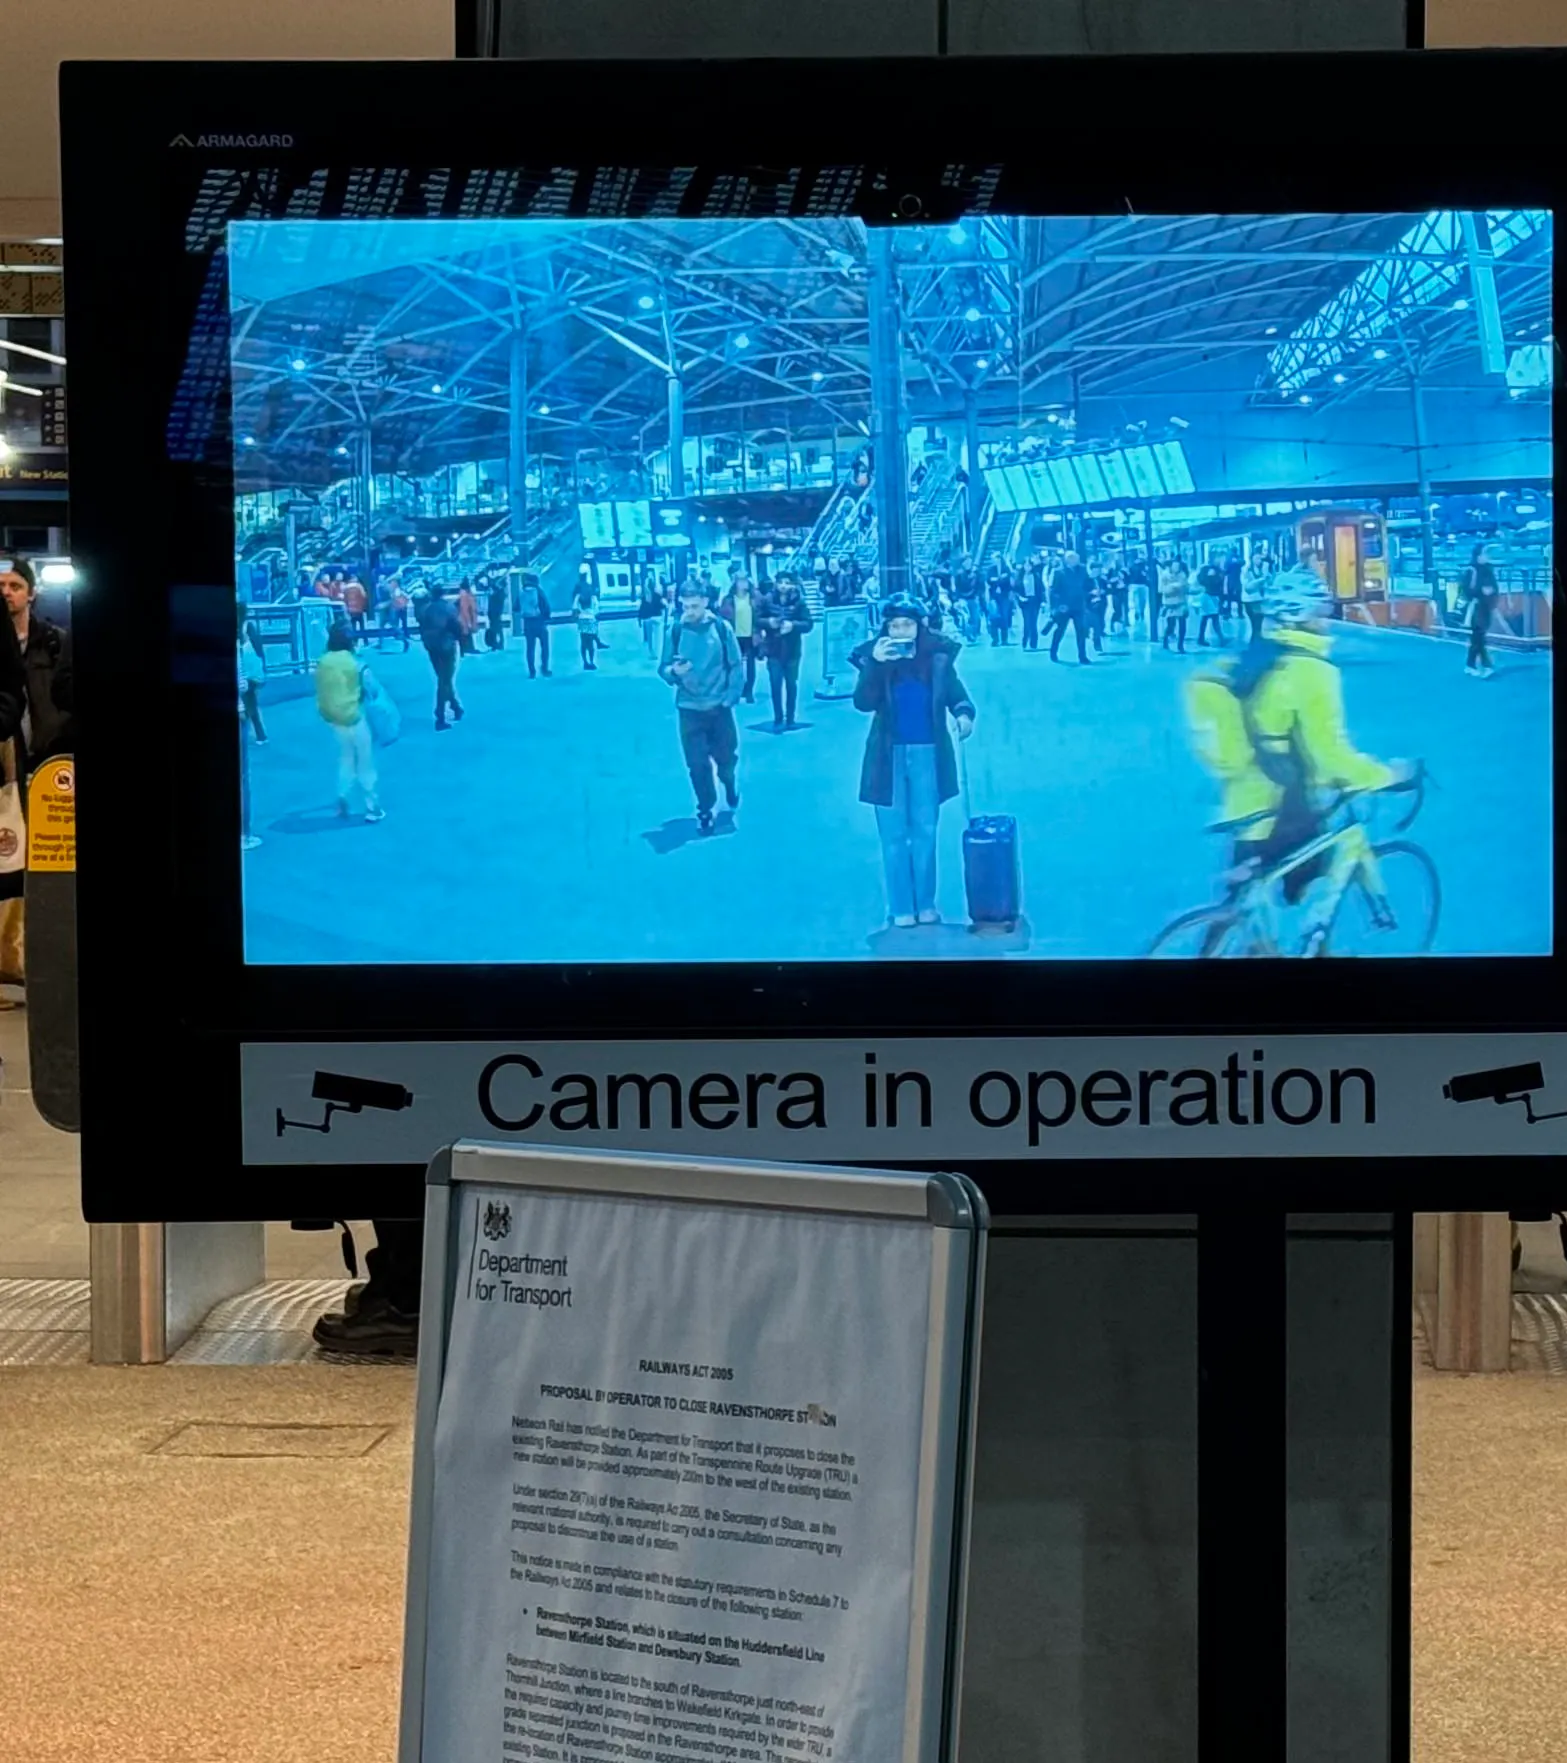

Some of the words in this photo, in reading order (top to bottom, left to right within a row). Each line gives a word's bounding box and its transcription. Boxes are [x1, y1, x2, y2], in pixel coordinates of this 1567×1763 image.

[197, 134, 294, 147] ARMAGARD
[477, 1054, 828, 1131] Camera
[865, 1052, 932, 1128] in
[969, 1049, 1376, 1147] operation
[479, 1249, 568, 1278] Department
[475, 1278, 496, 1301] for
[501, 1280, 572, 1310] Transport
[639, 1359, 690, 1378] RAILWAYS
[692, 1365, 708, 1378] ACT
[711, 1366, 734, 1381] 2005
[541, 1384, 593, 1402] PROPOSAL
[607, 1391, 662, 1409] OPERATOR
[664, 1396, 677, 1410] TO
[679, 1398, 708, 1414] CLOSE
[709, 1402, 795, 1422] RAVENSTHORPE
[567, 1422, 583, 1433] has
[612, 1427, 626, 1439] the
[629, 1428, 679, 1445] Department
[692, 1435, 733, 1452] Transport
[736, 1441, 754, 1453] that
[764, 1445, 804, 1459] proposes
[842, 1453, 854, 1465] the
[636, 1447, 648, 1459] As
[650, 1450, 666, 1463] part
[756, 1460, 783, 1474] Route
[576, 1458, 586, 1468] be
[706, 1474, 715, 1484] to
[718, 1474, 732, 1487] the
[735, 1478, 756, 1489] west
[759, 1479, 769, 1490] of
[771, 1479, 785, 1493] the
[788, 1483, 820, 1500] existing
[514, 1484, 536, 1497] Under
[539, 1488, 568, 1500] section
[610, 1496, 624, 1508] the
[704, 1508, 720, 1520] the
[723, 1510, 768, 1528] Secretary
[770, 1516, 779, 1527] of
[809, 1523, 820, 1533] as
[823, 1523, 836, 1535] the
[601, 1531, 615, 1543] the
[618, 1534, 633, 1544] use
[636, 1534, 645, 1545] of
[692, 1527, 706, 1538] out
[717, 1530, 773, 1545] consultation
[826, 1543, 842, 1557] any
[529, 1555, 553, 1568] notice
[593, 1565, 642, 1581] compliance
[510, 1568, 523, 1580] the
[595, 1582, 612, 1593] and
[700, 1596, 709, 1608] of
[713, 1597, 727, 1612] the
[730, 1599, 768, 1620] following
[569, 1630, 604, 1646] Mirfield
[607, 1635, 636, 1650] Station
[639, 1643, 653, 1654] and
[655, 1643, 702, 1664] Dewsbury
[705, 1651, 741, 1668] Station.
[632, 1622, 655, 1636] which
[668, 1628, 706, 1645] situated
[709, 1635, 721, 1647] on
[724, 1636, 739, 1650] the
[742, 1638, 803, 1659] Huddersfield
[805, 1647, 824, 1663] Line
[575, 1684, 602, 1697] where
[678, 1700, 721, 1717] Wakefield
[653, 1681, 678, 1695] south
[680, 1683, 689, 1695] of
[692, 1684, 755, 1706] Ravensthorpe
[757, 1696, 773, 1709] just
